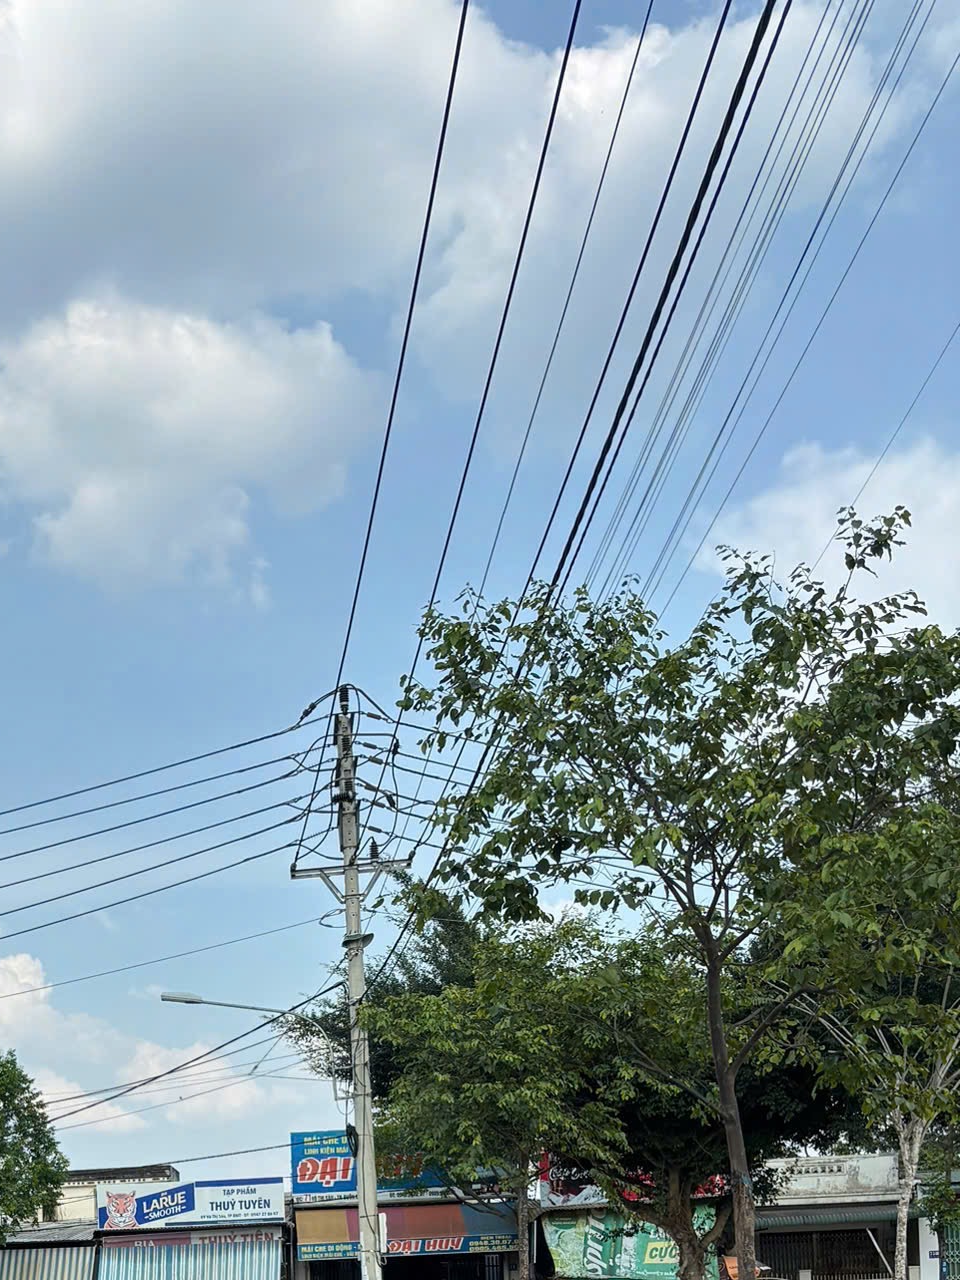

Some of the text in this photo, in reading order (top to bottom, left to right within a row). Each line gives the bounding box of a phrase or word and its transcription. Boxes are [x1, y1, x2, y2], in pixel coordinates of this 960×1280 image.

[297, 1157, 354, 1187] ĐẠI
[143, 1192, 186, 1213] LARUE
[388, 1237, 464, 1254] ĐẠI HUY
